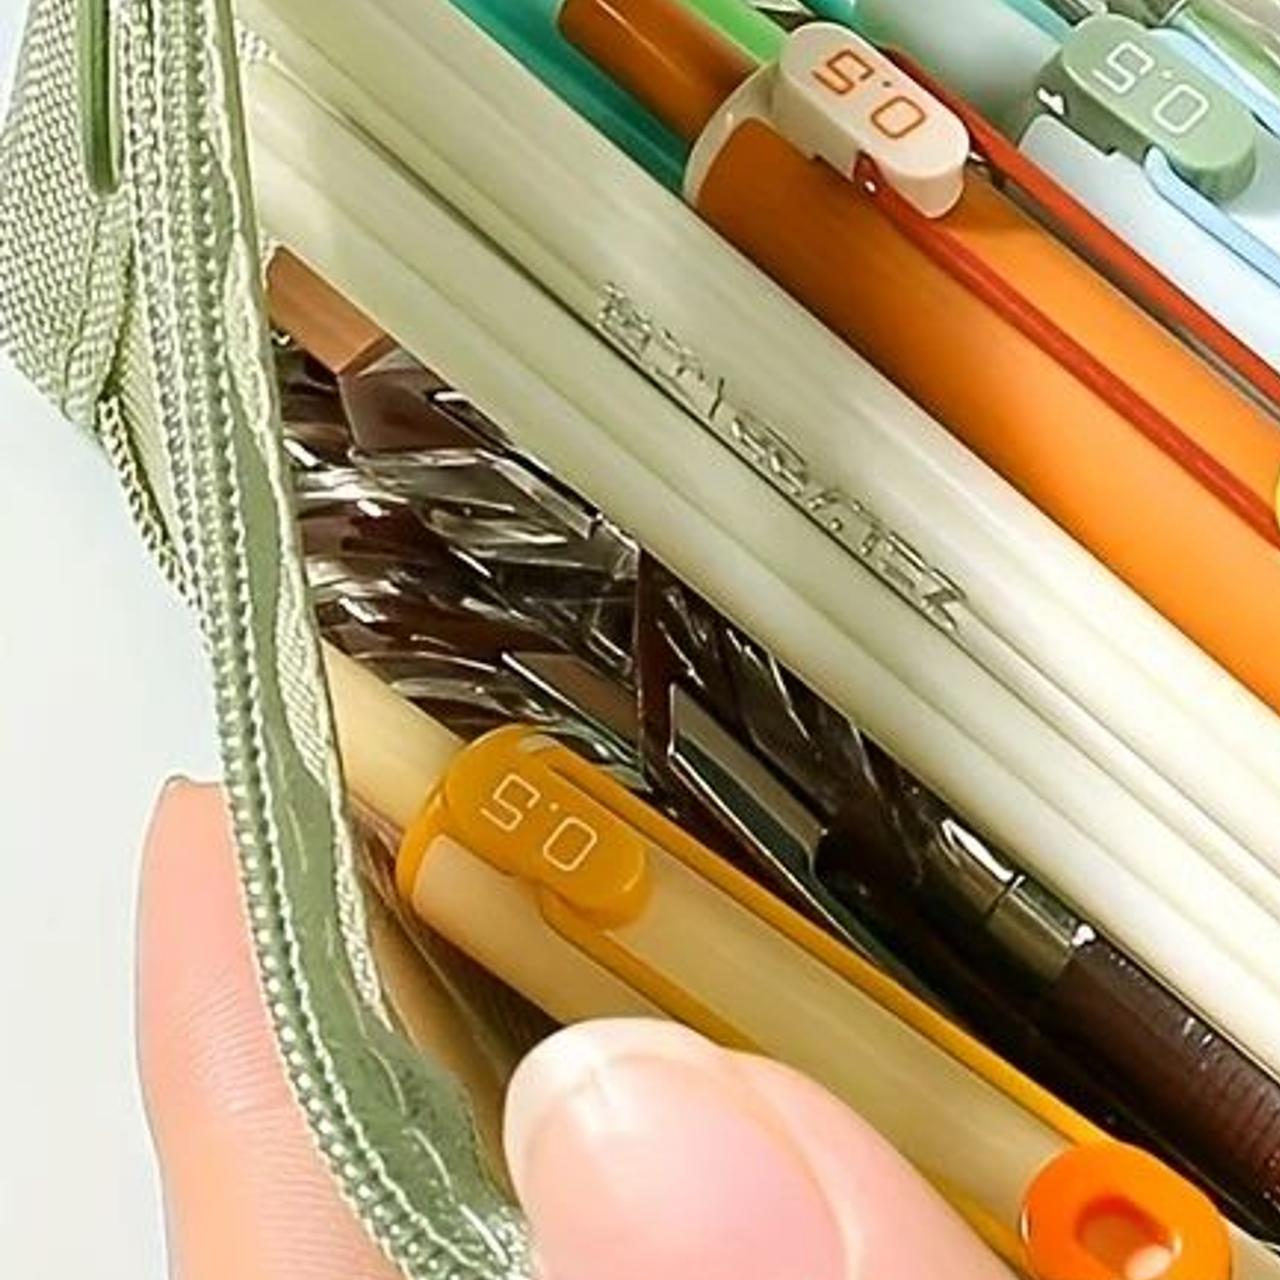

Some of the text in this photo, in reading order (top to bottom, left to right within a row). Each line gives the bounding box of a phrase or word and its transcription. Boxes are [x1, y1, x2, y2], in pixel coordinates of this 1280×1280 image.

[812, 49, 926, 139] 0.5
[1092, 40, 1209, 133] 0.5
[479, 773, 597, 871] 0.5
